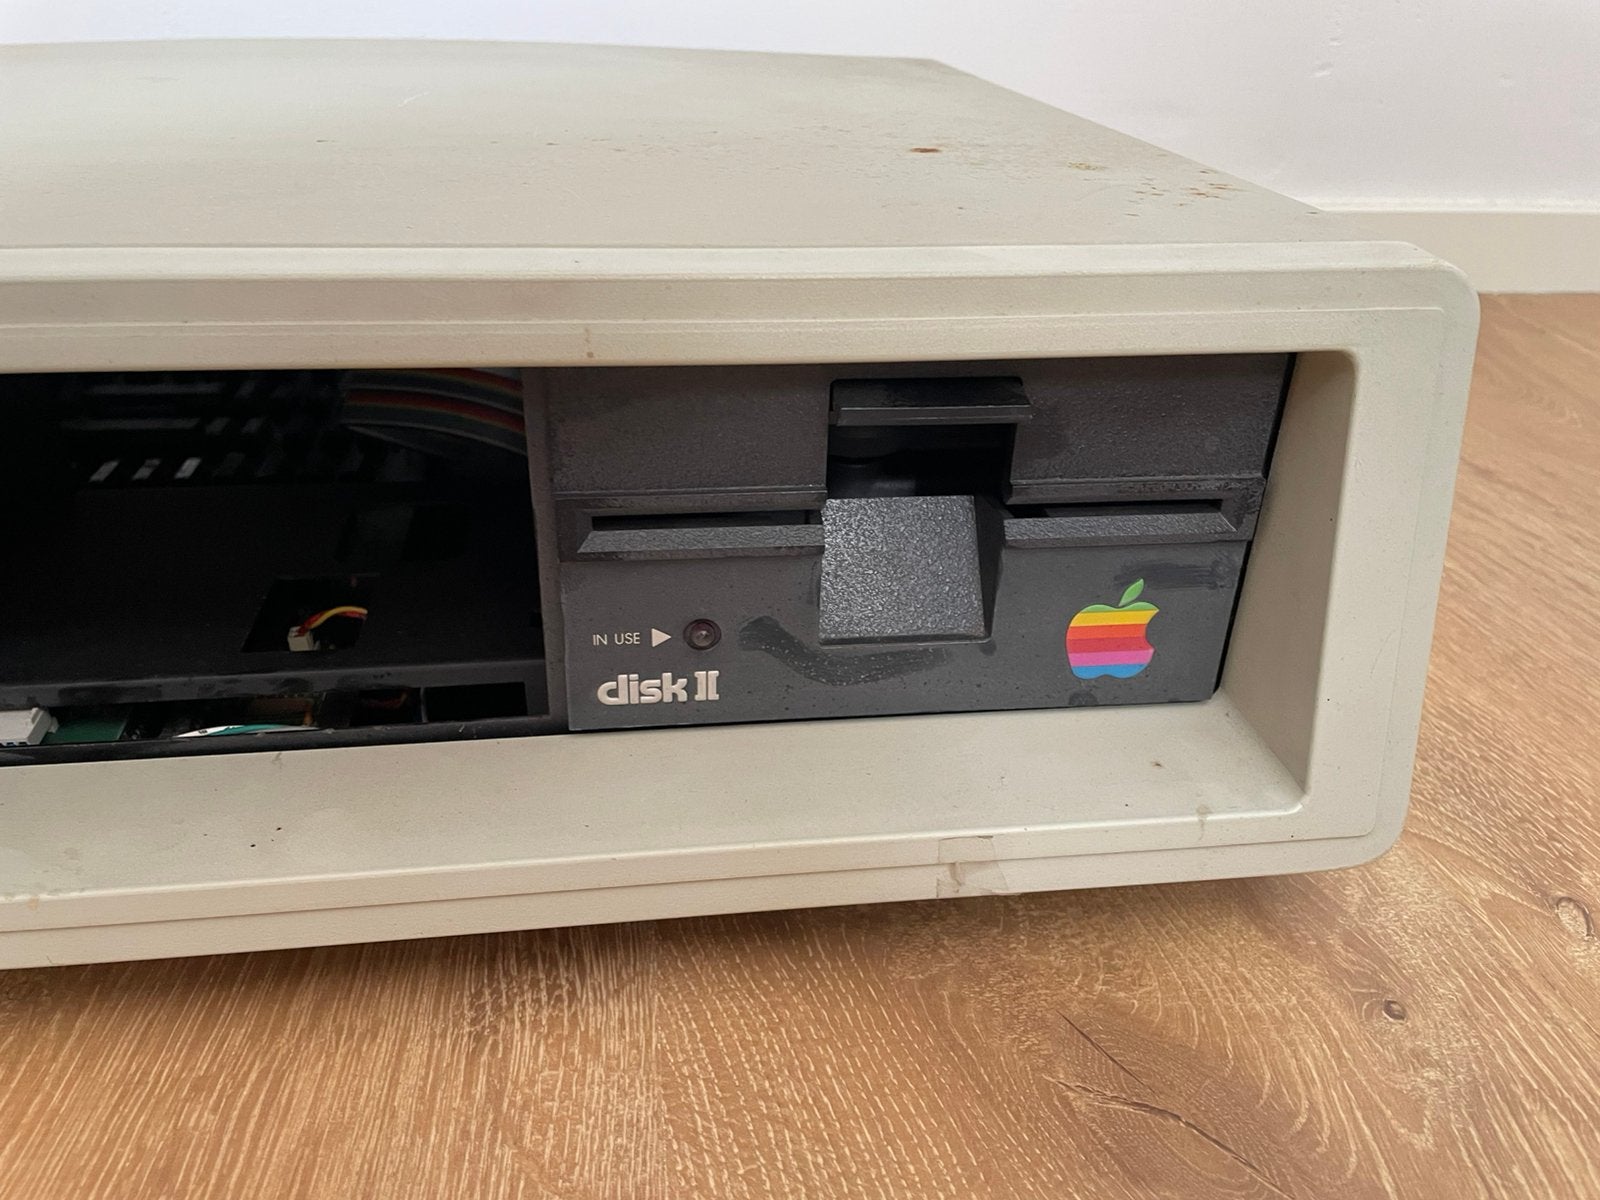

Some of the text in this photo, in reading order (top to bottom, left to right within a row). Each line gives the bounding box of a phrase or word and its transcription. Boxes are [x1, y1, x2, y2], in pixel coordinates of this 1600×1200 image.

[593, 632, 641, 646] IN USE
[597, 672, 688, 706] disk
